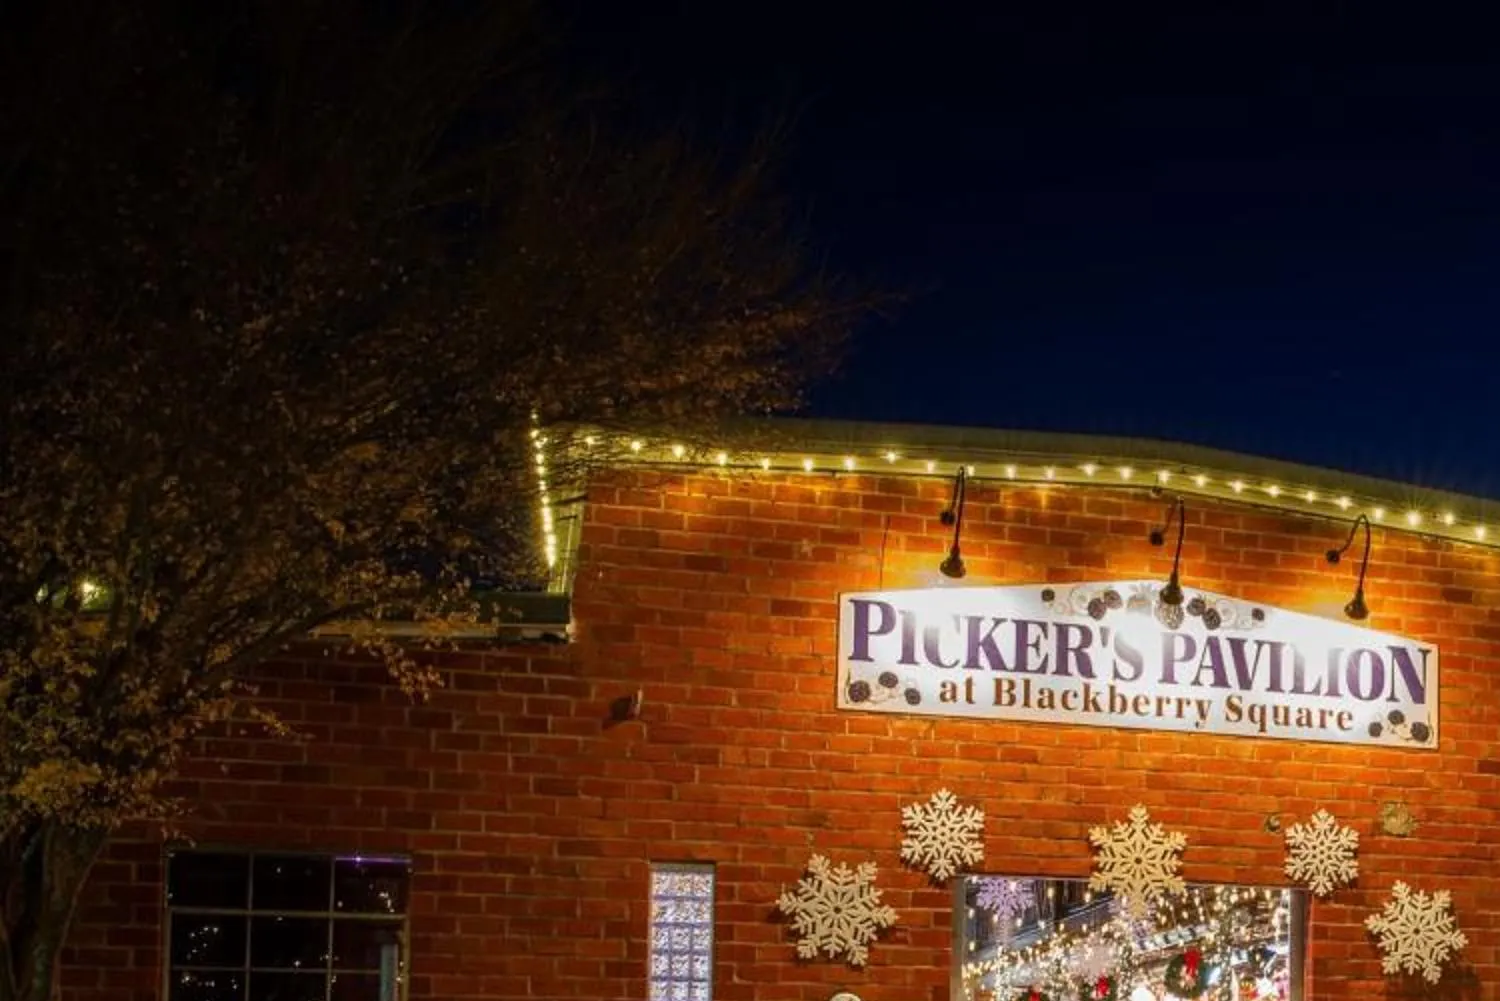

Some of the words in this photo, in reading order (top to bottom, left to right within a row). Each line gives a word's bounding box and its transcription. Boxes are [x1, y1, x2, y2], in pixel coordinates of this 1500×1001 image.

[847, 598, 1144, 682] PICKER'S
[1157, 631, 1432, 704] PAVILION
[939, 676, 974, 706] at
[993, 677, 1212, 728] Blackberry
[1224, 696, 1354, 732] Square
